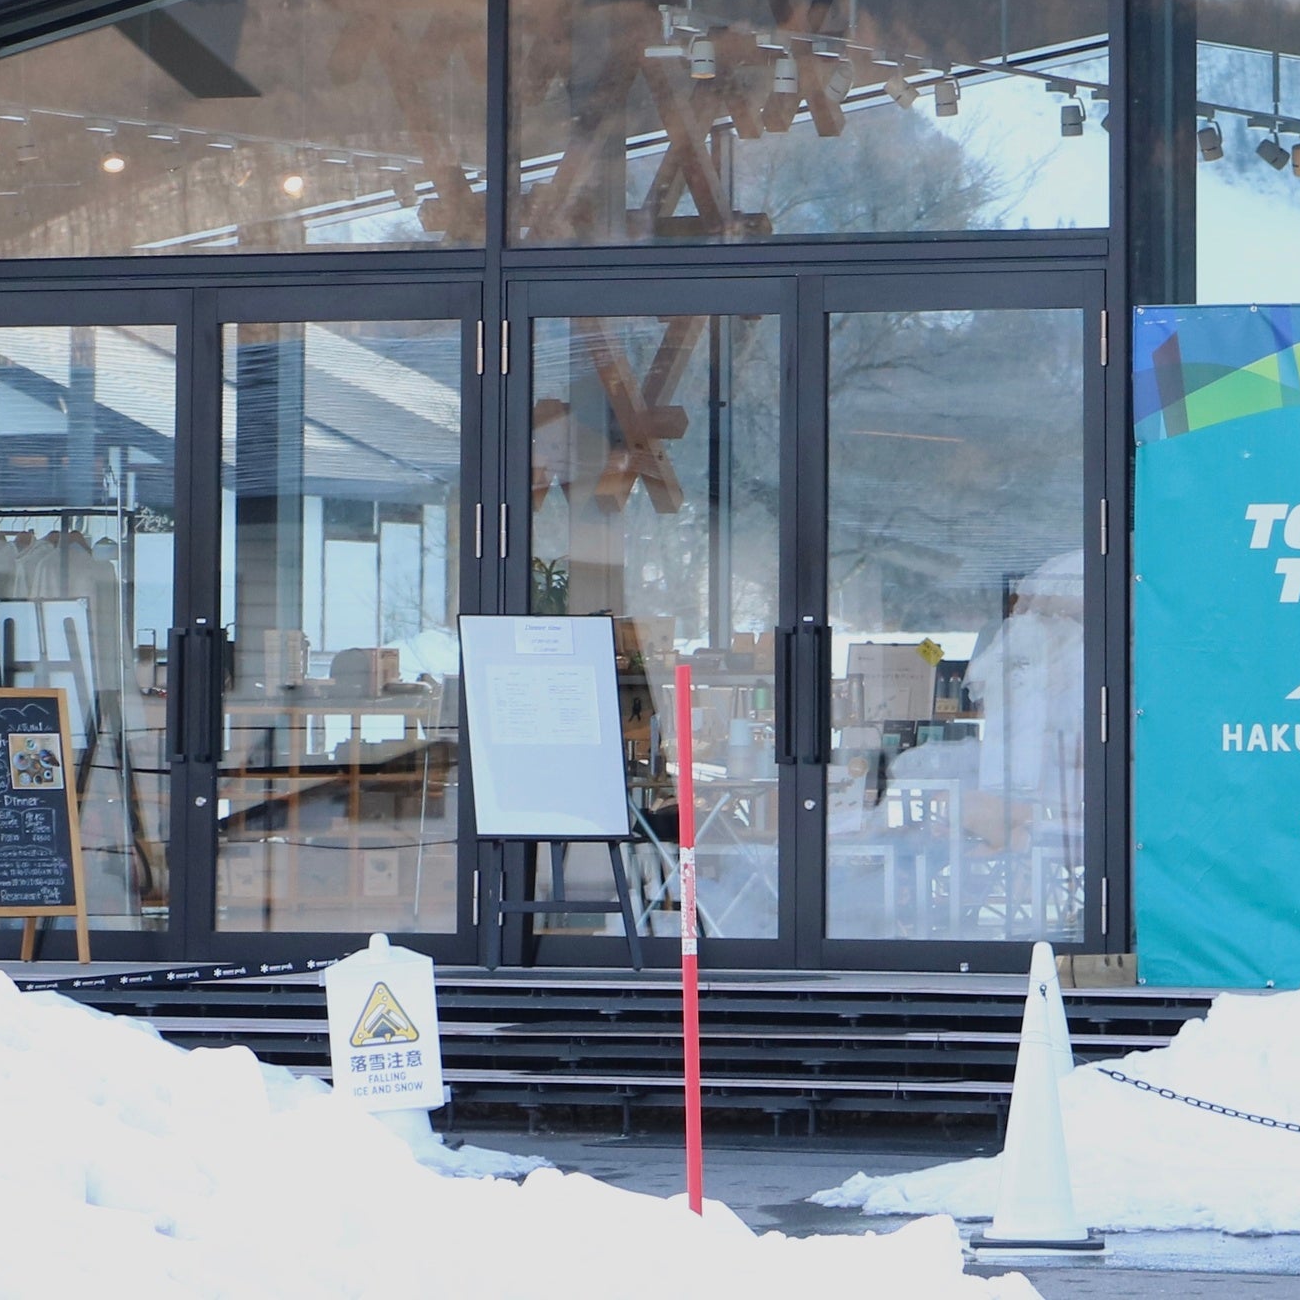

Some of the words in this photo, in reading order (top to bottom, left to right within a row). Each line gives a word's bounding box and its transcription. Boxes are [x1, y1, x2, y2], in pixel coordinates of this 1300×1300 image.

[350, 1050, 423, 1073] 落雪注意
[368, 1072, 406, 1083] FALLING
[353, 1087, 368, 1096] ICE
[372, 1084, 391, 1094] AND
[395, 1081, 423, 1092] SNOW
